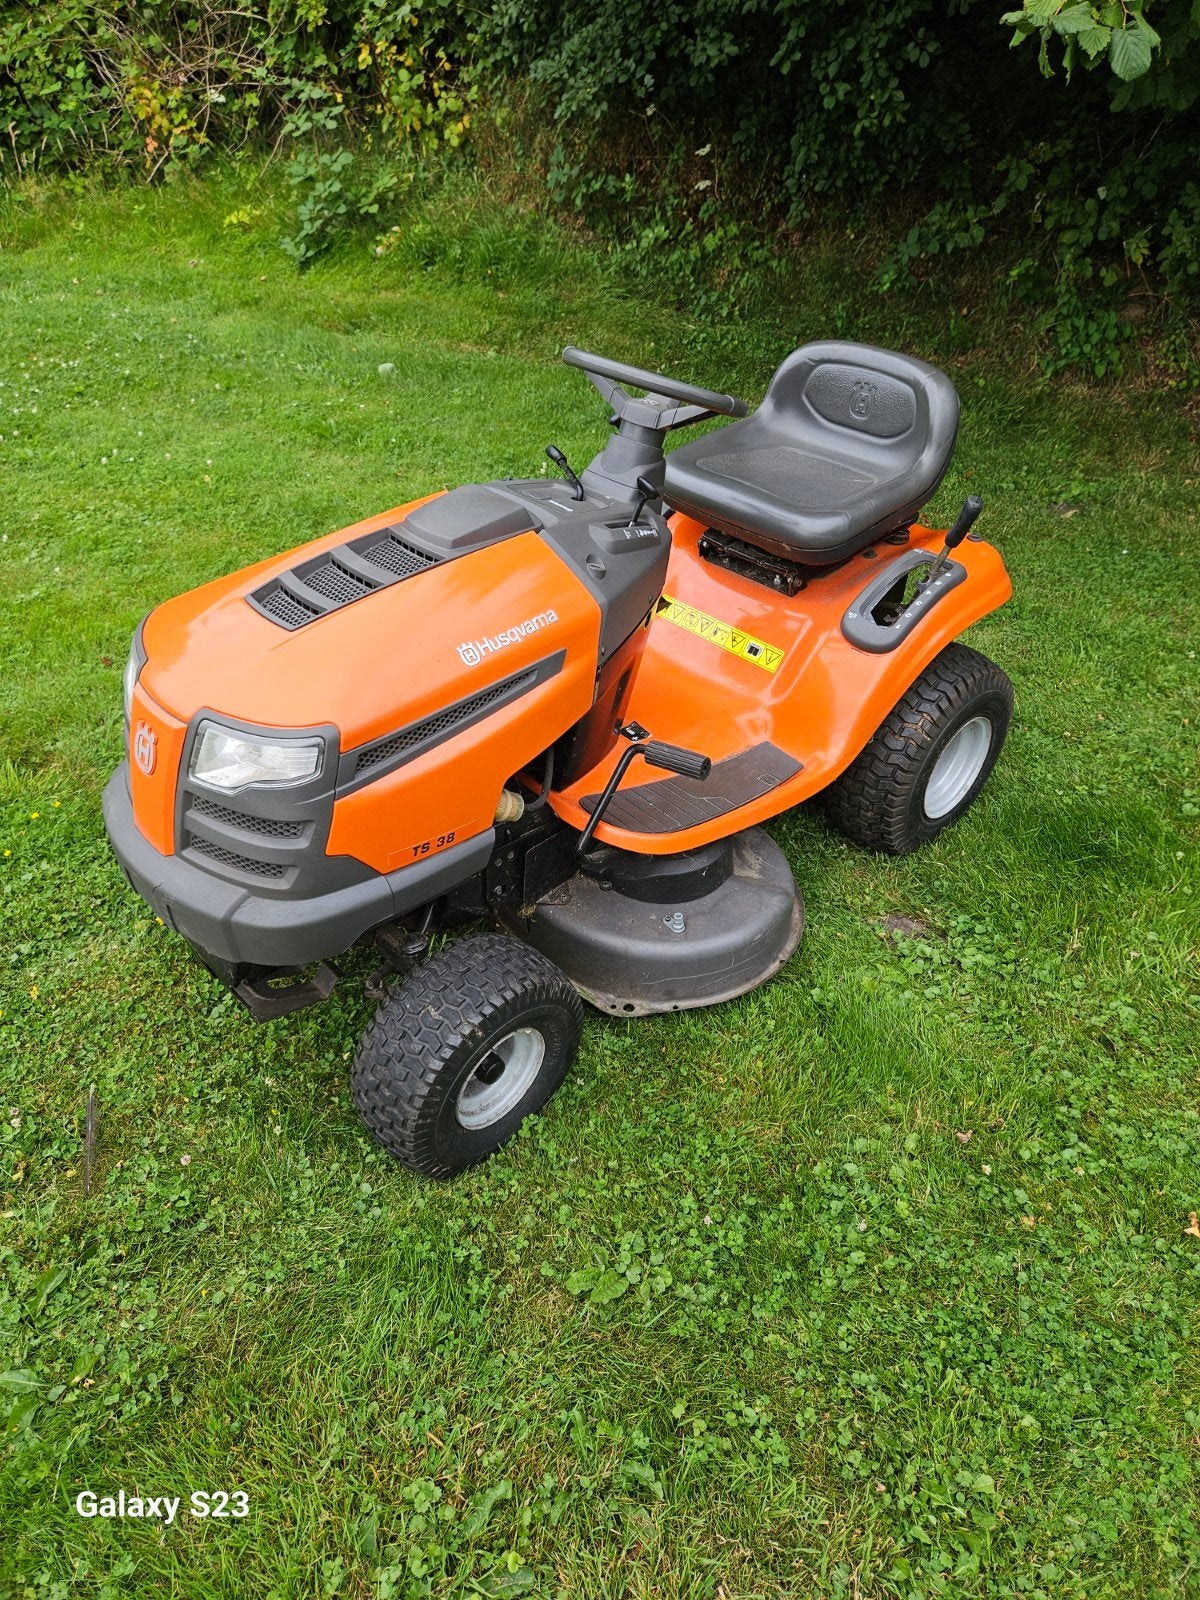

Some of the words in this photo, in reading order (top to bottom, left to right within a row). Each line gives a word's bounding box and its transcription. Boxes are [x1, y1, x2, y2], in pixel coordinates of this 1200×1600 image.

[476, 609, 560, 657] Husqvarna
[412, 841, 431, 857] TS
[436, 831, 456, 848] 38
